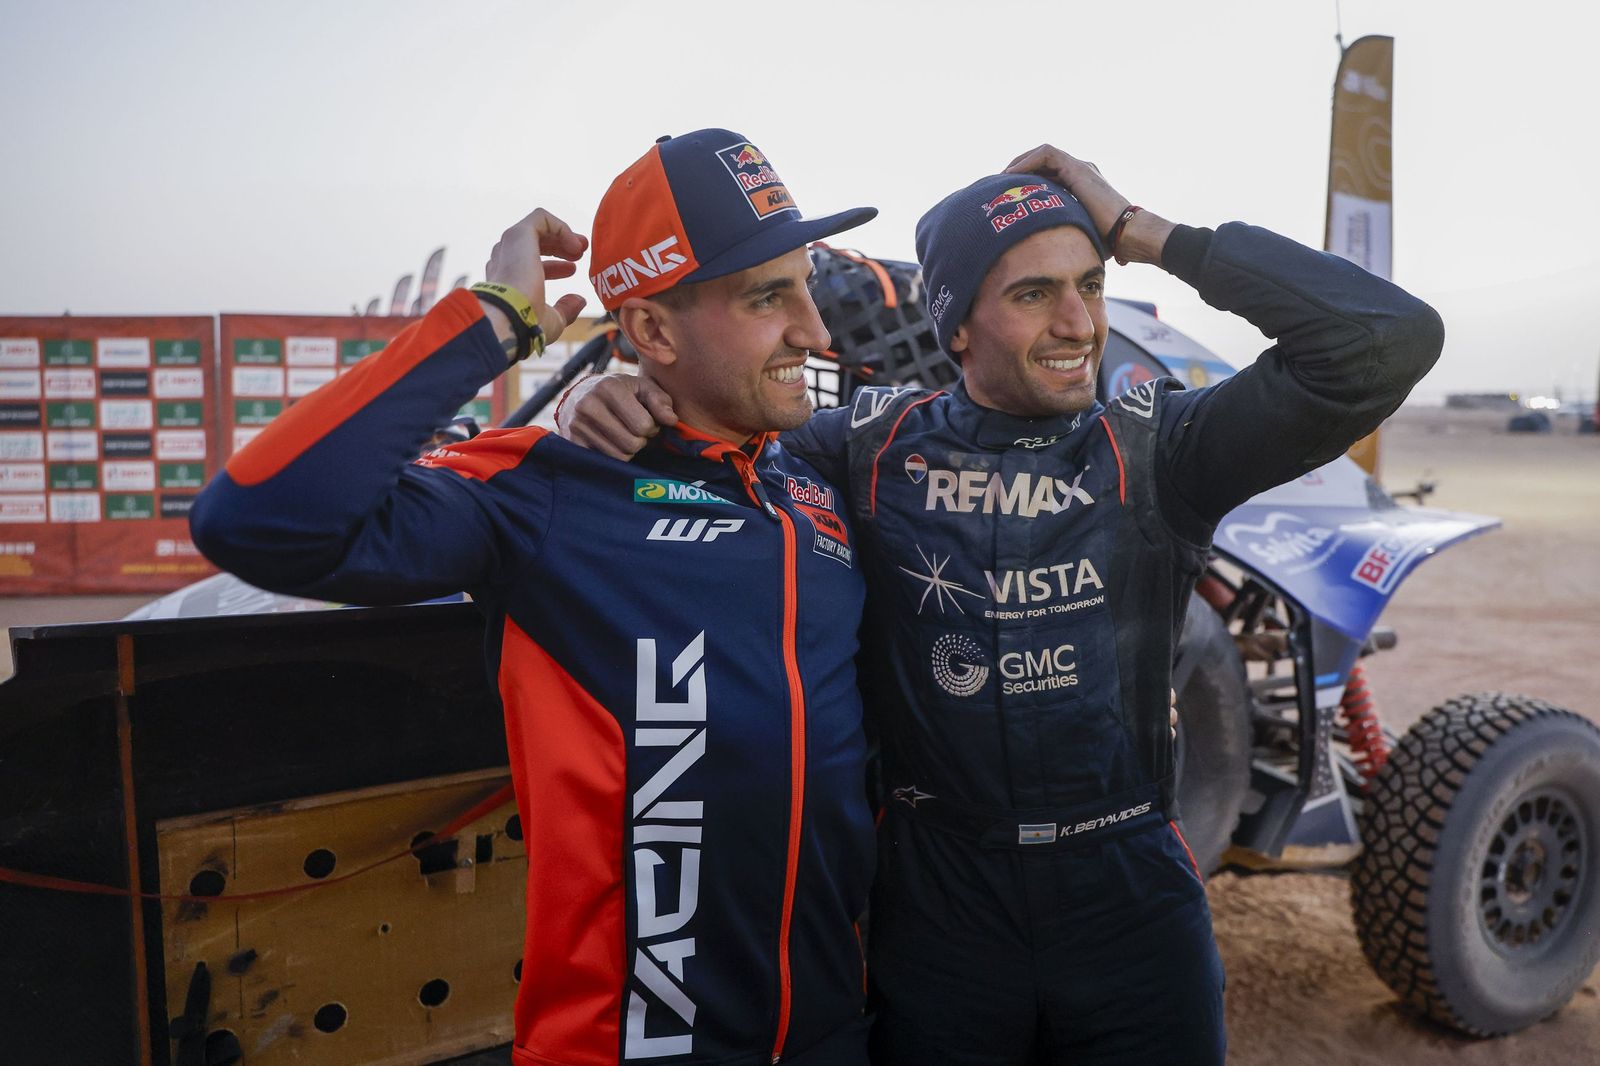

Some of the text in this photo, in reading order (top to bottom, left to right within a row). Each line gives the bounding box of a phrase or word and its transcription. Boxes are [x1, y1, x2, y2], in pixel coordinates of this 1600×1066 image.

[737, 166, 769, 191] Red
[991, 194, 1065, 233] Red Bull
[590, 235, 688, 300] ACING
[932, 284, 950, 317] GMC
[787, 476, 832, 510] Red Bull
[646, 518, 746, 542] WP
[816, 534, 836, 553] FACTORY
[984, 558, 1104, 604] VISTA
[984, 595, 1105, 620] ENERGY FOR TOMORROW
[1000, 644, 1076, 679] GMC
[1002, 674, 1079, 695] Securities
[624, 629, 707, 1060] RACING
